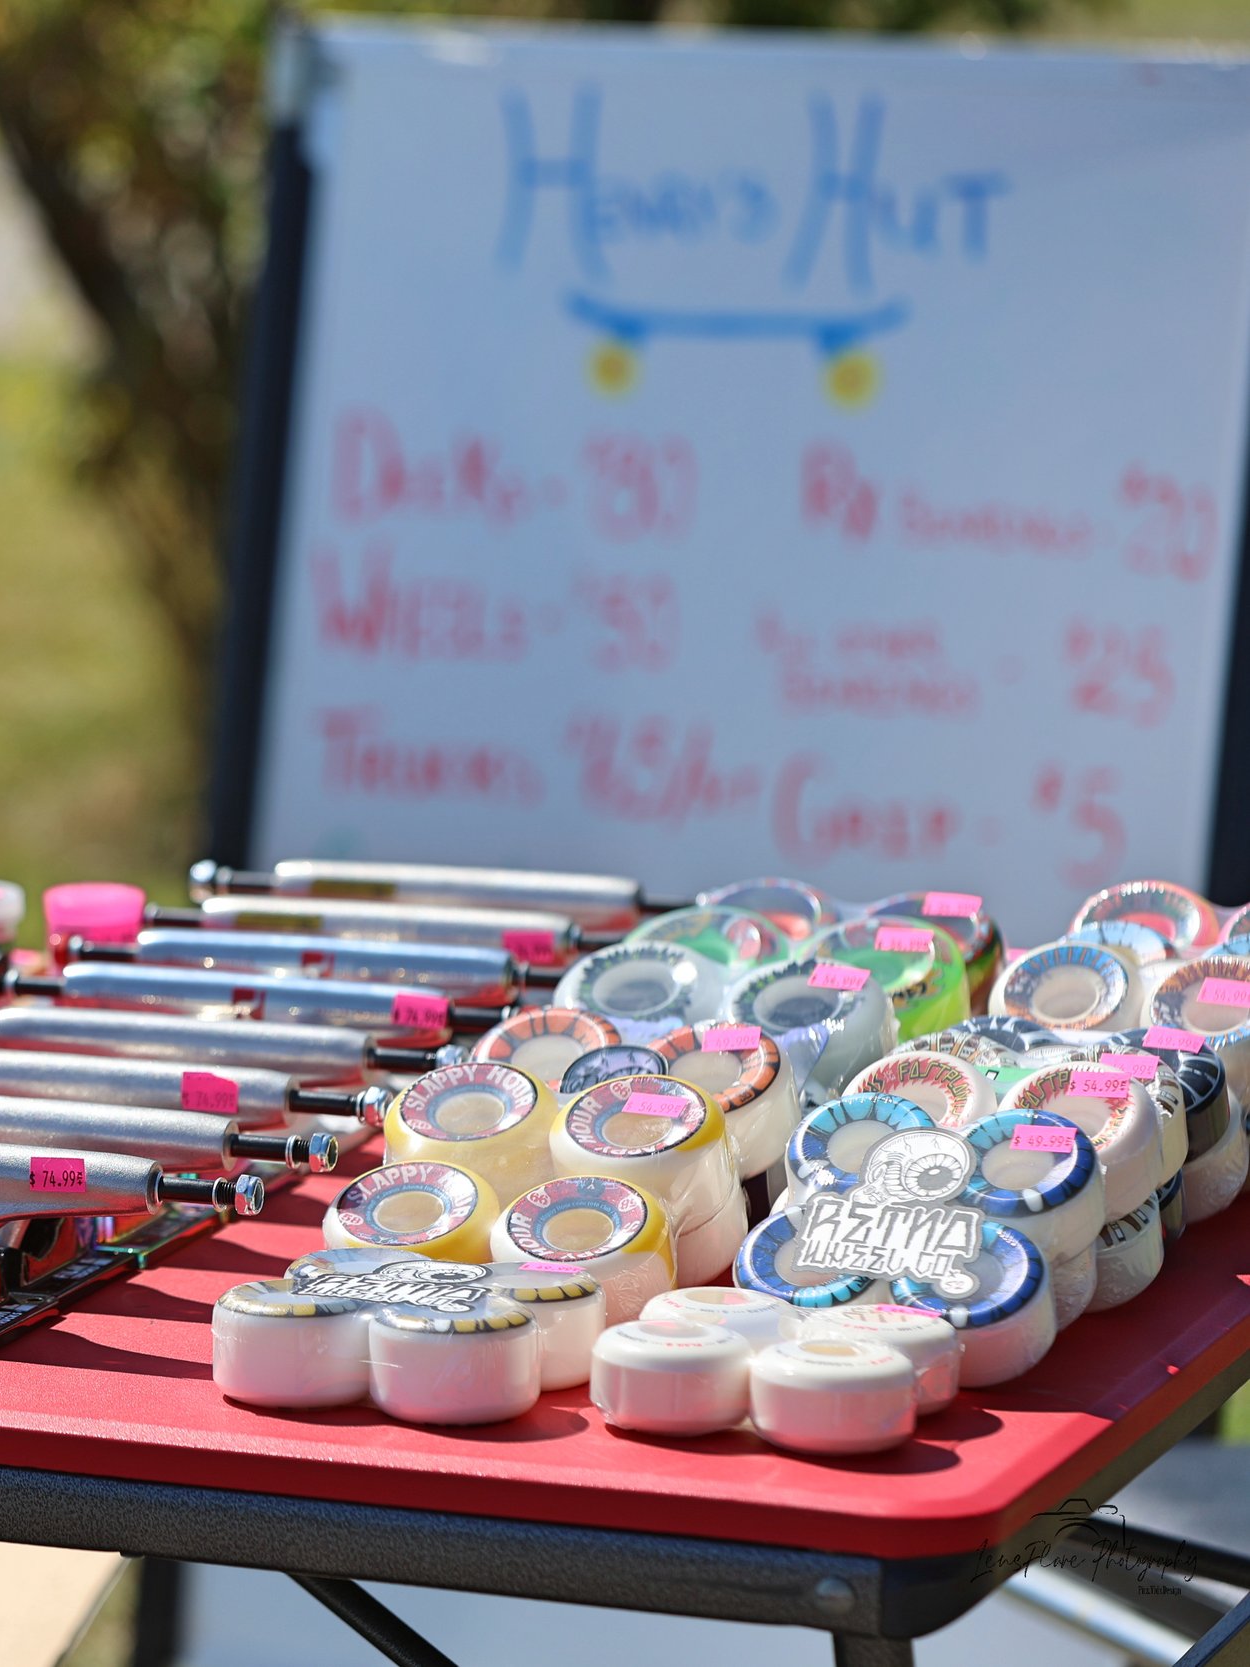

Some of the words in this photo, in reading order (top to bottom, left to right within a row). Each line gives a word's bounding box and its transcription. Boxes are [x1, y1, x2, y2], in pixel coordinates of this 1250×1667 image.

[405, 1064, 478, 1112] SLAPPY
[486, 1064, 535, 1110] HOUR
[570, 1095, 604, 1145] HOUR
[346, 1163, 434, 1202] SLAPPY
[510, 1211, 555, 1257] HOUR
[806, 1199, 975, 1251] RETNA
[803, 1239, 902, 1275] WHEEL
